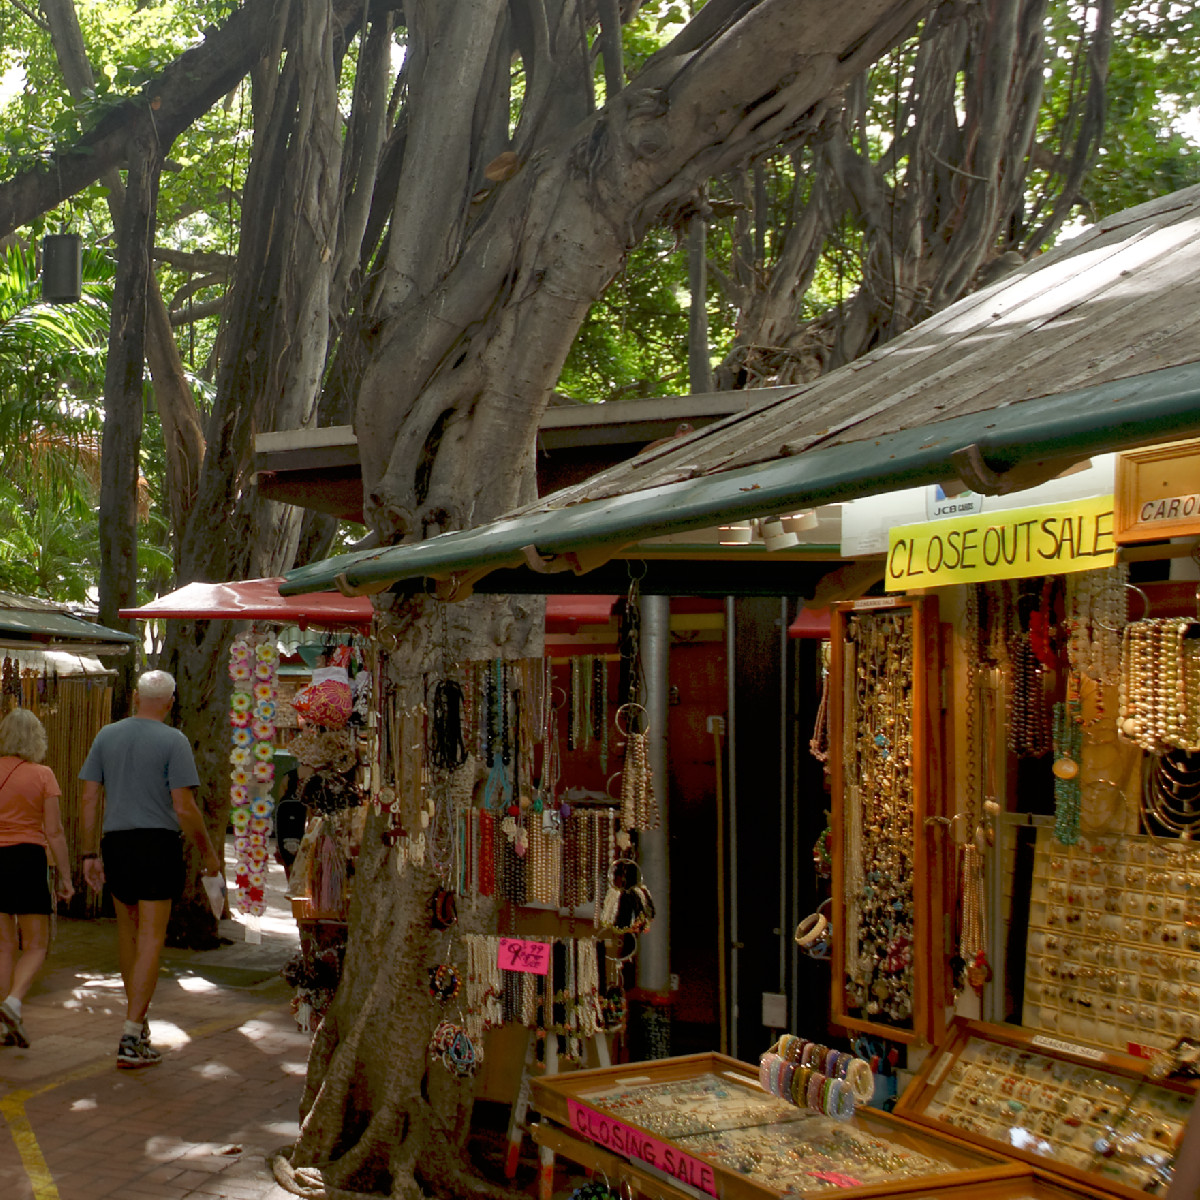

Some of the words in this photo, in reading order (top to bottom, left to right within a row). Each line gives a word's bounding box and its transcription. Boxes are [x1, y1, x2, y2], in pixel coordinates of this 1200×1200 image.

[934, 505, 956, 515] JCB
[1141, 497, 1200, 521] CARO
[1037, 511, 1113, 559] SALE
[576, 1109, 657, 1165] CLOSING
[663, 1150, 713, 1196] SALE
